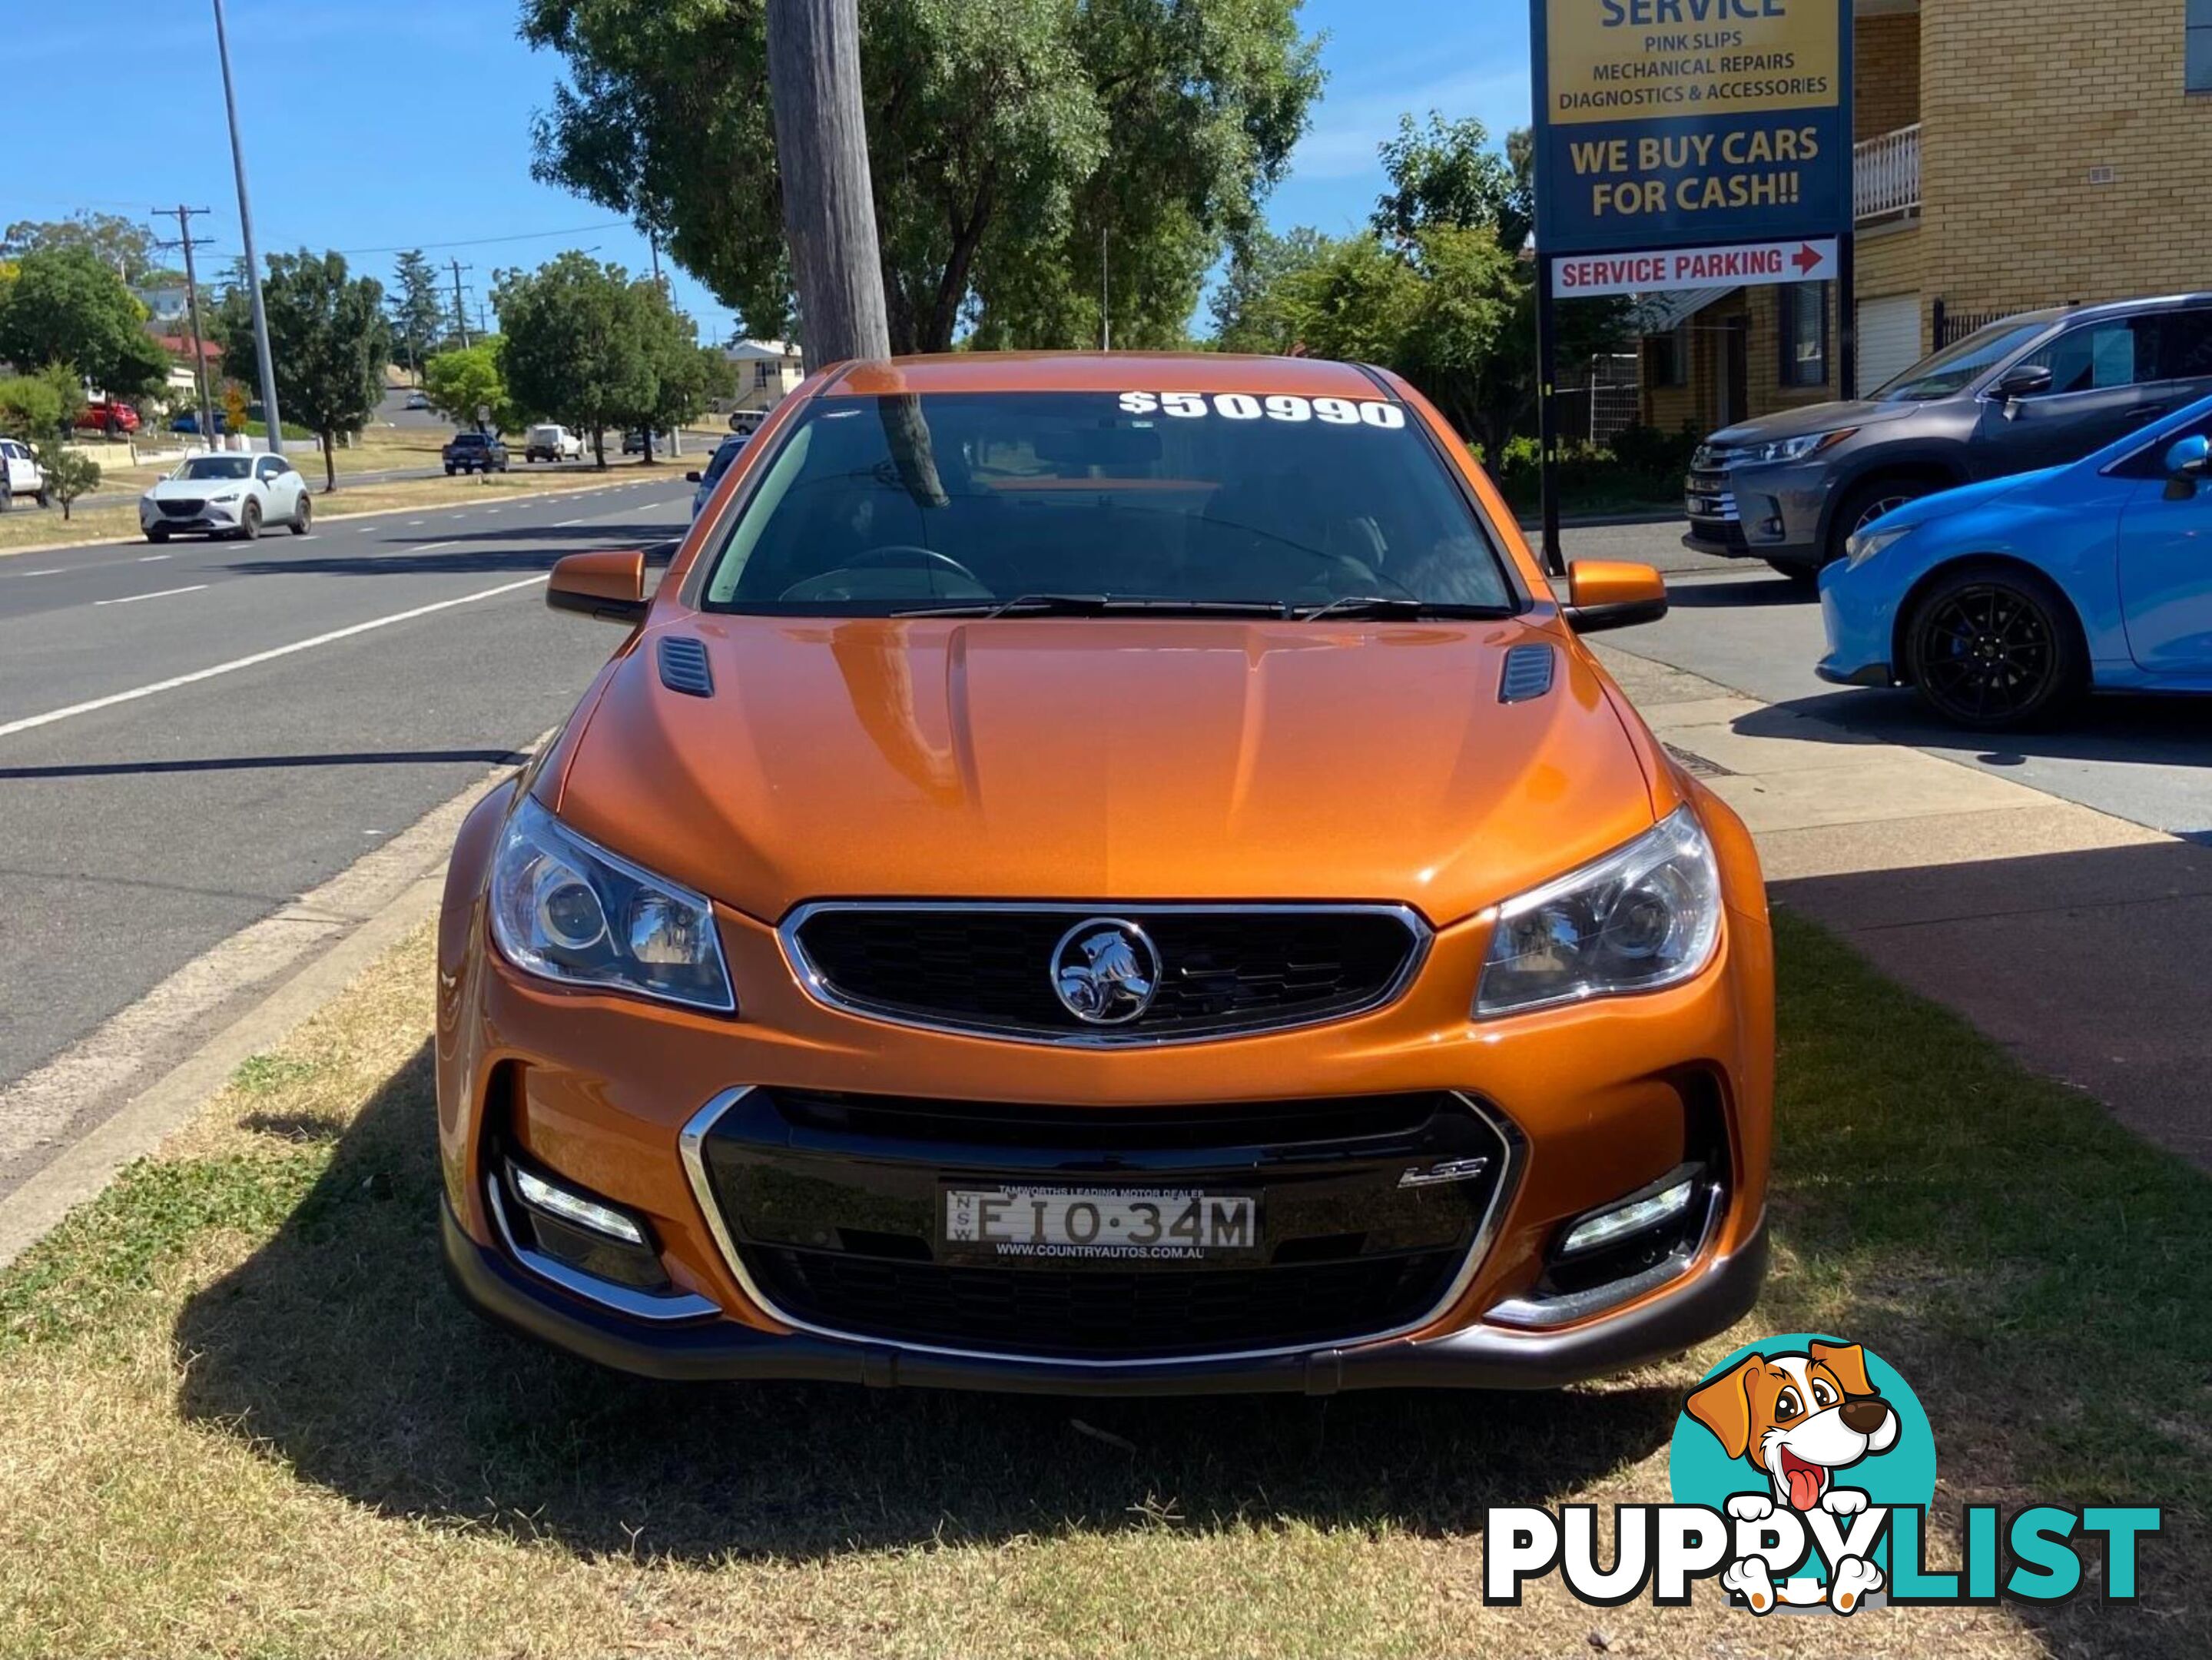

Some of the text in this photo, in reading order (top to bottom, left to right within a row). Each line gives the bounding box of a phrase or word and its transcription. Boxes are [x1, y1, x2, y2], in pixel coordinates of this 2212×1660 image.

[1602, 0, 1786, 27] SERVICE
[1645, 31, 1743, 52] PINK SLIPS
[1593, 53, 1795, 81] MECHANICAL REPAIRS
[1560, 77, 1827, 109] DIAGNOSTICS & ACCESSORIES
[1570, 127, 1819, 174] WE BUY CARS
[1593, 171, 1799, 216] FOR CASH!!
[1562, 250, 1783, 287] SERVICE PARKING
[1119, 391, 1405, 428] $50990
[996, 1243, 1204, 1259] WWW.COUNTRYAUTOS.COM.AU
